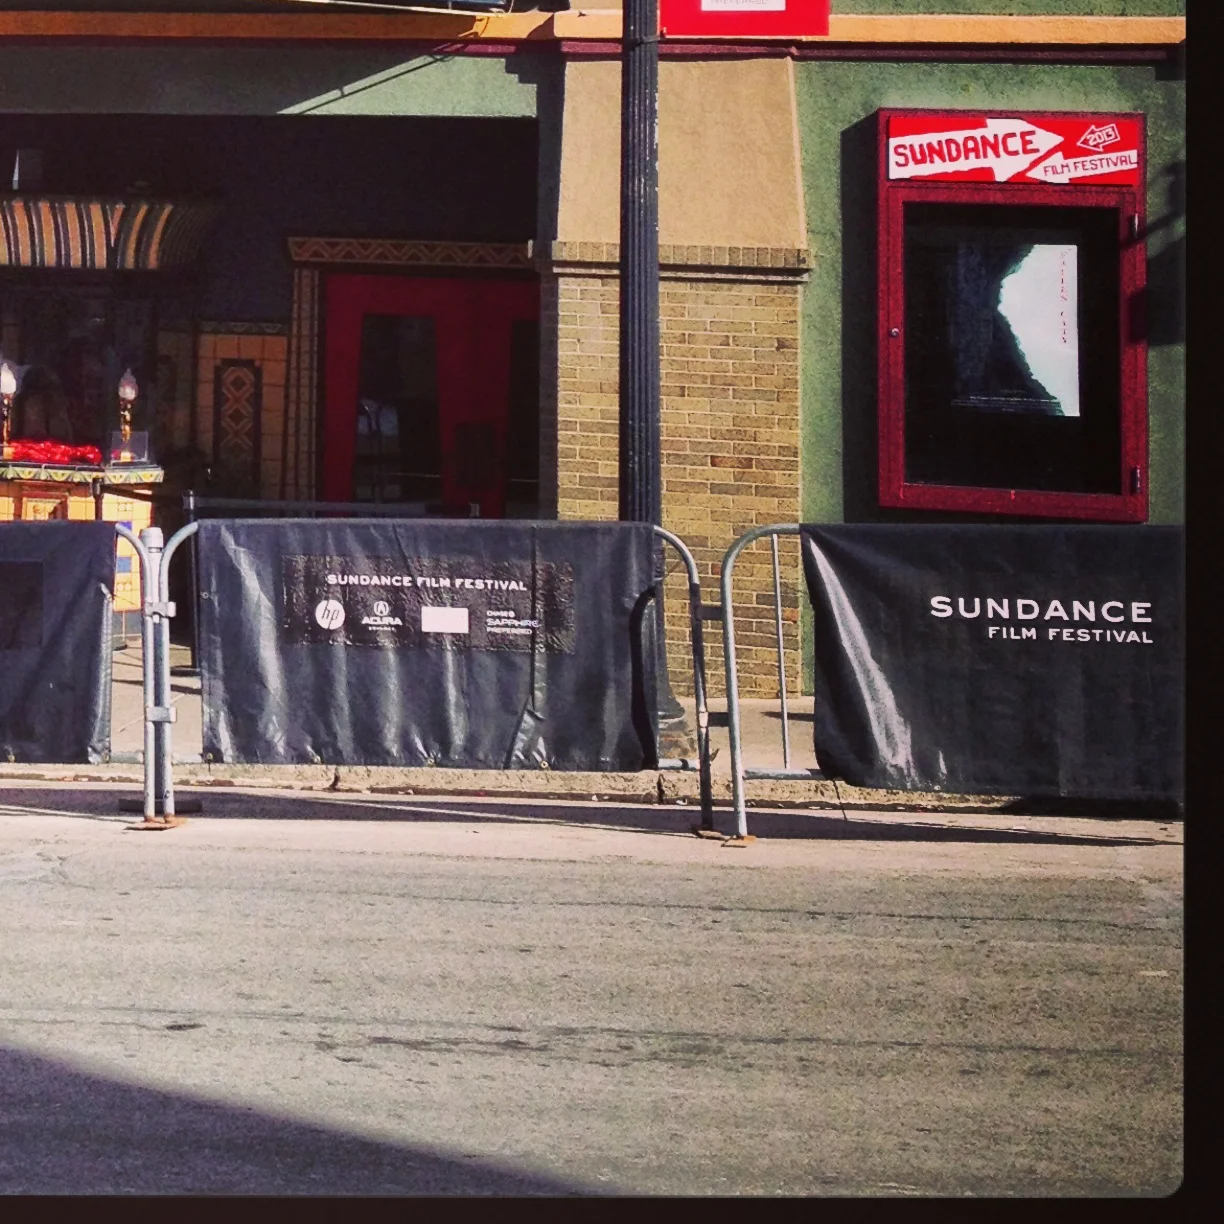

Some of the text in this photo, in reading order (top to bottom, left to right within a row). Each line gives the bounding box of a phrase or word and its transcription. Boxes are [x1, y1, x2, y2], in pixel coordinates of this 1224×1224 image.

[1086, 128, 1116, 146] 2013
[893, 130, 1041, 168] SUNDANCE
[1043, 154, 1139, 177] FILM FESTIVAL
[327, 574, 528, 591] SUNDANCE FILM FESTIVAL
[930, 595, 1153, 624] SUNDANCE
[361, 616, 404, 626] ACURA
[988, 627, 1154, 644] FILM FESTIVAL
